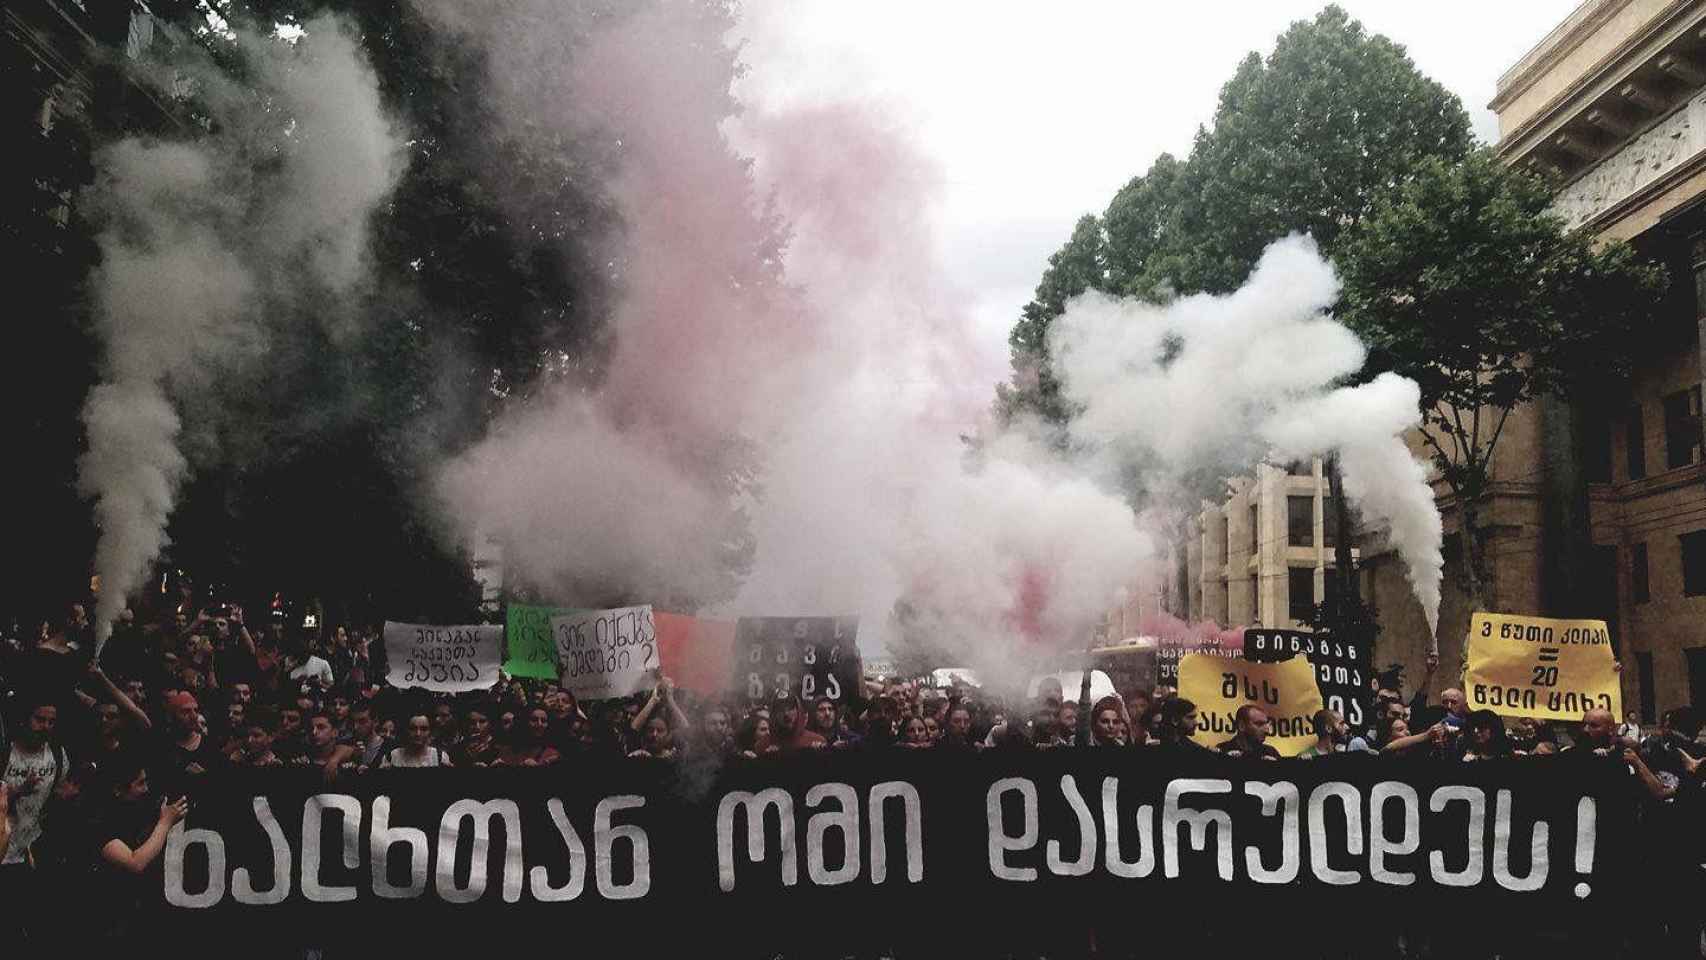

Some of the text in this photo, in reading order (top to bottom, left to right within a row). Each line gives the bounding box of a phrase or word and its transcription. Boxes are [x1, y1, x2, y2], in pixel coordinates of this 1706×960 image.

[1256, 634, 1357, 660] შინაგან
[1501, 623, 1553, 643] წუთი
[1560, 628, 1608, 645] კლიპი
[405, 659, 480, 683] მაფია
[1532, 666, 1559, 687] 20
[1220, 672, 1279, 705] შსს
[1474, 684, 1536, 710] წელი
[164, 794, 651, 907] ხალხთან
[716, 781, 923, 892] ომი
